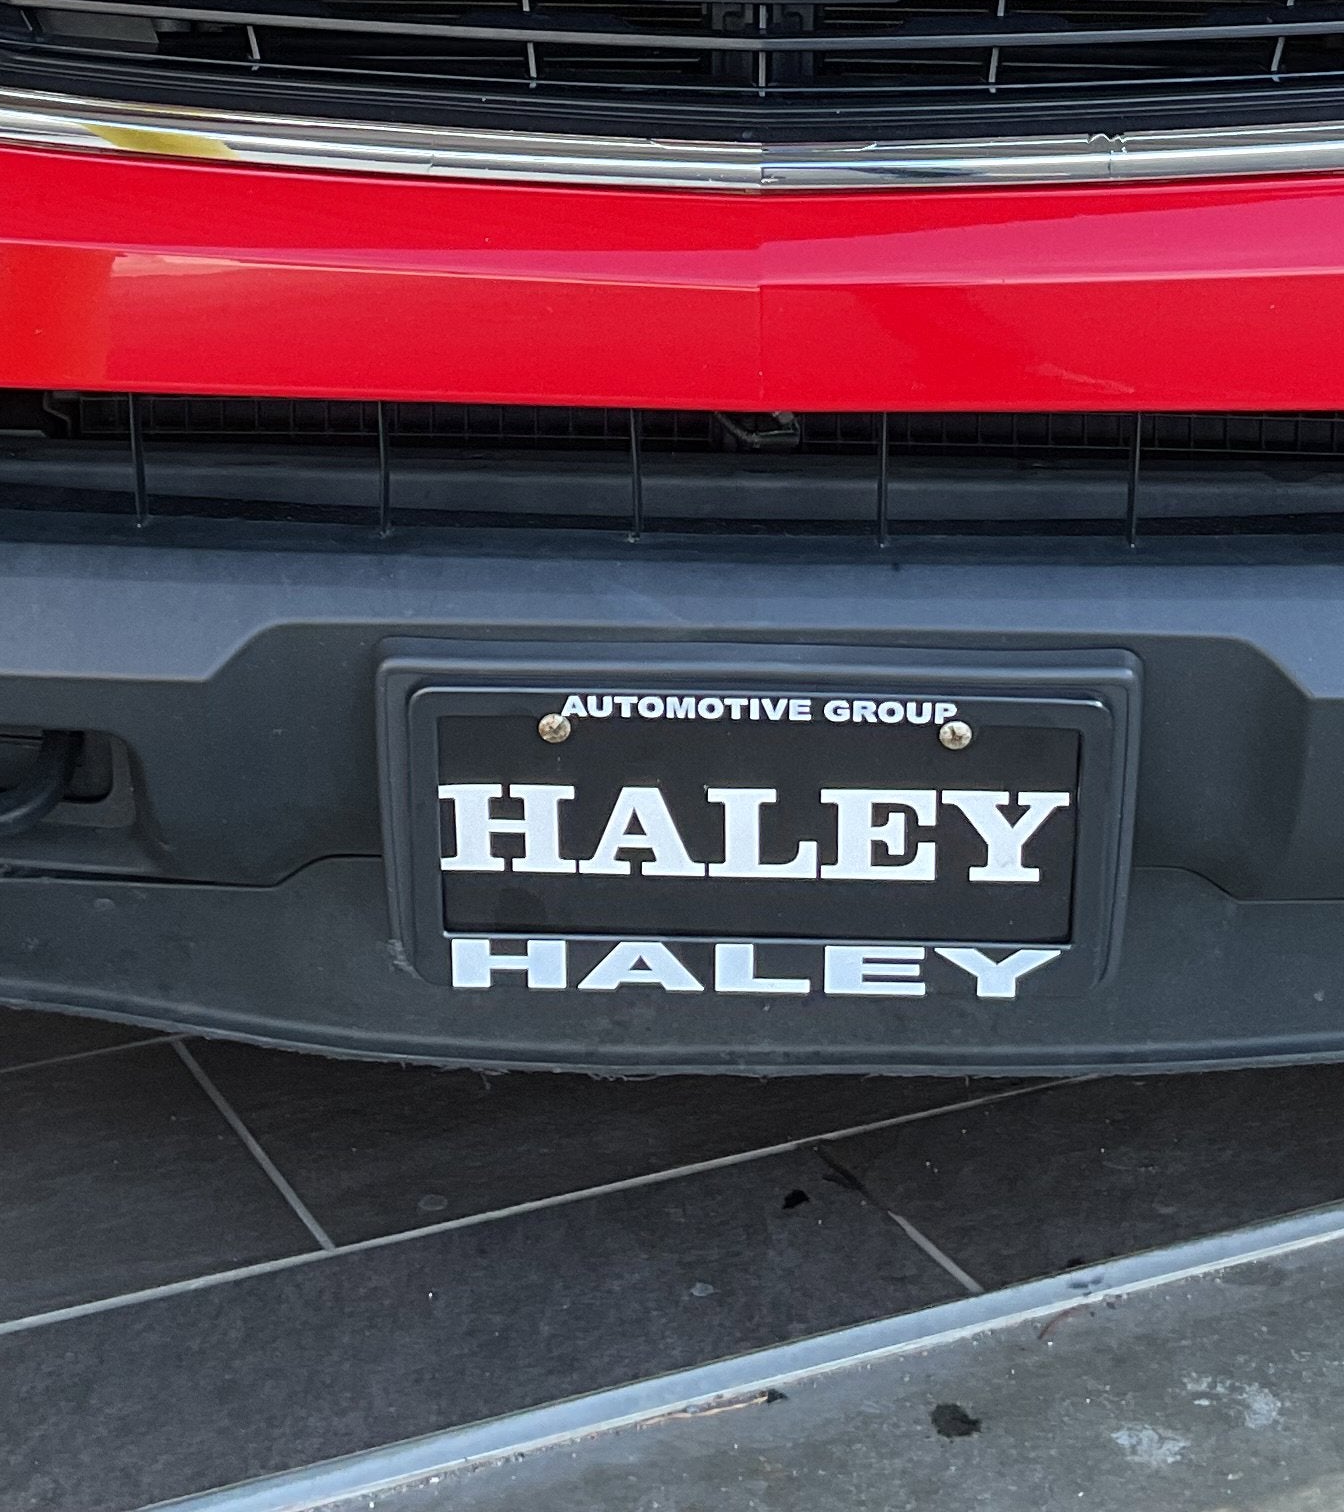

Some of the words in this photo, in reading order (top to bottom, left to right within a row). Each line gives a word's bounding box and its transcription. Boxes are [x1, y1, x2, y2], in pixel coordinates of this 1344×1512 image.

[561, 694, 812, 722] AUTOMOTIVE
[823, 699, 958, 725] GROUP
[437, 782, 1071, 883] HALEY
[451, 938, 1063, 999] HALEY
